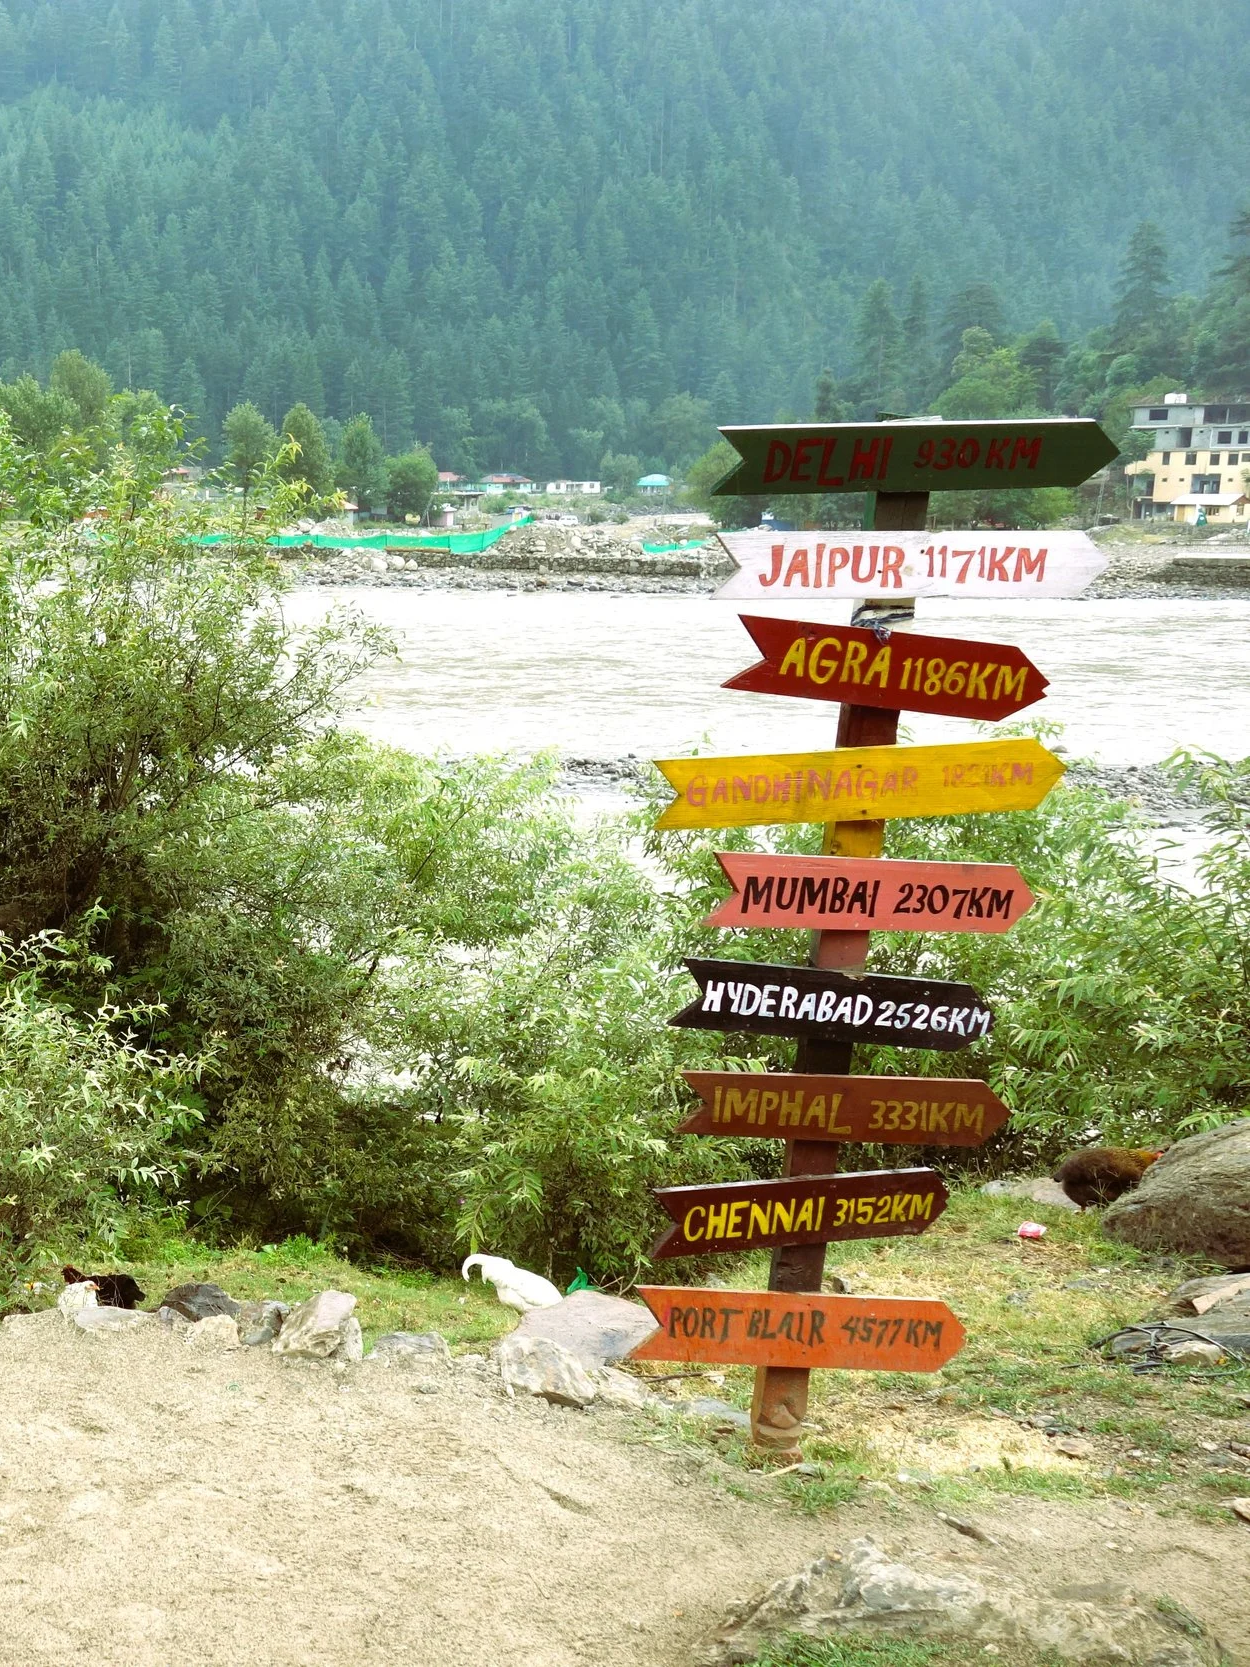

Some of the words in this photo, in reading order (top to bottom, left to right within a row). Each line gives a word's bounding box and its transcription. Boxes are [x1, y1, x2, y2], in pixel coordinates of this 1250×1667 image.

[763, 436, 894, 486] DELHI
[759, 543, 905, 588] JAIPUR
[778, 637, 890, 689] AGRA
[741, 876, 880, 918] MUMBAI
[702, 980, 873, 1026] HYDERABAD
[712, 1085, 851, 1135] IMPHAL
[683, 1197, 825, 1242] CHENNAI
[668, 1307, 743, 1344] PORT
[746, 1309, 825, 1347] BLAIR
